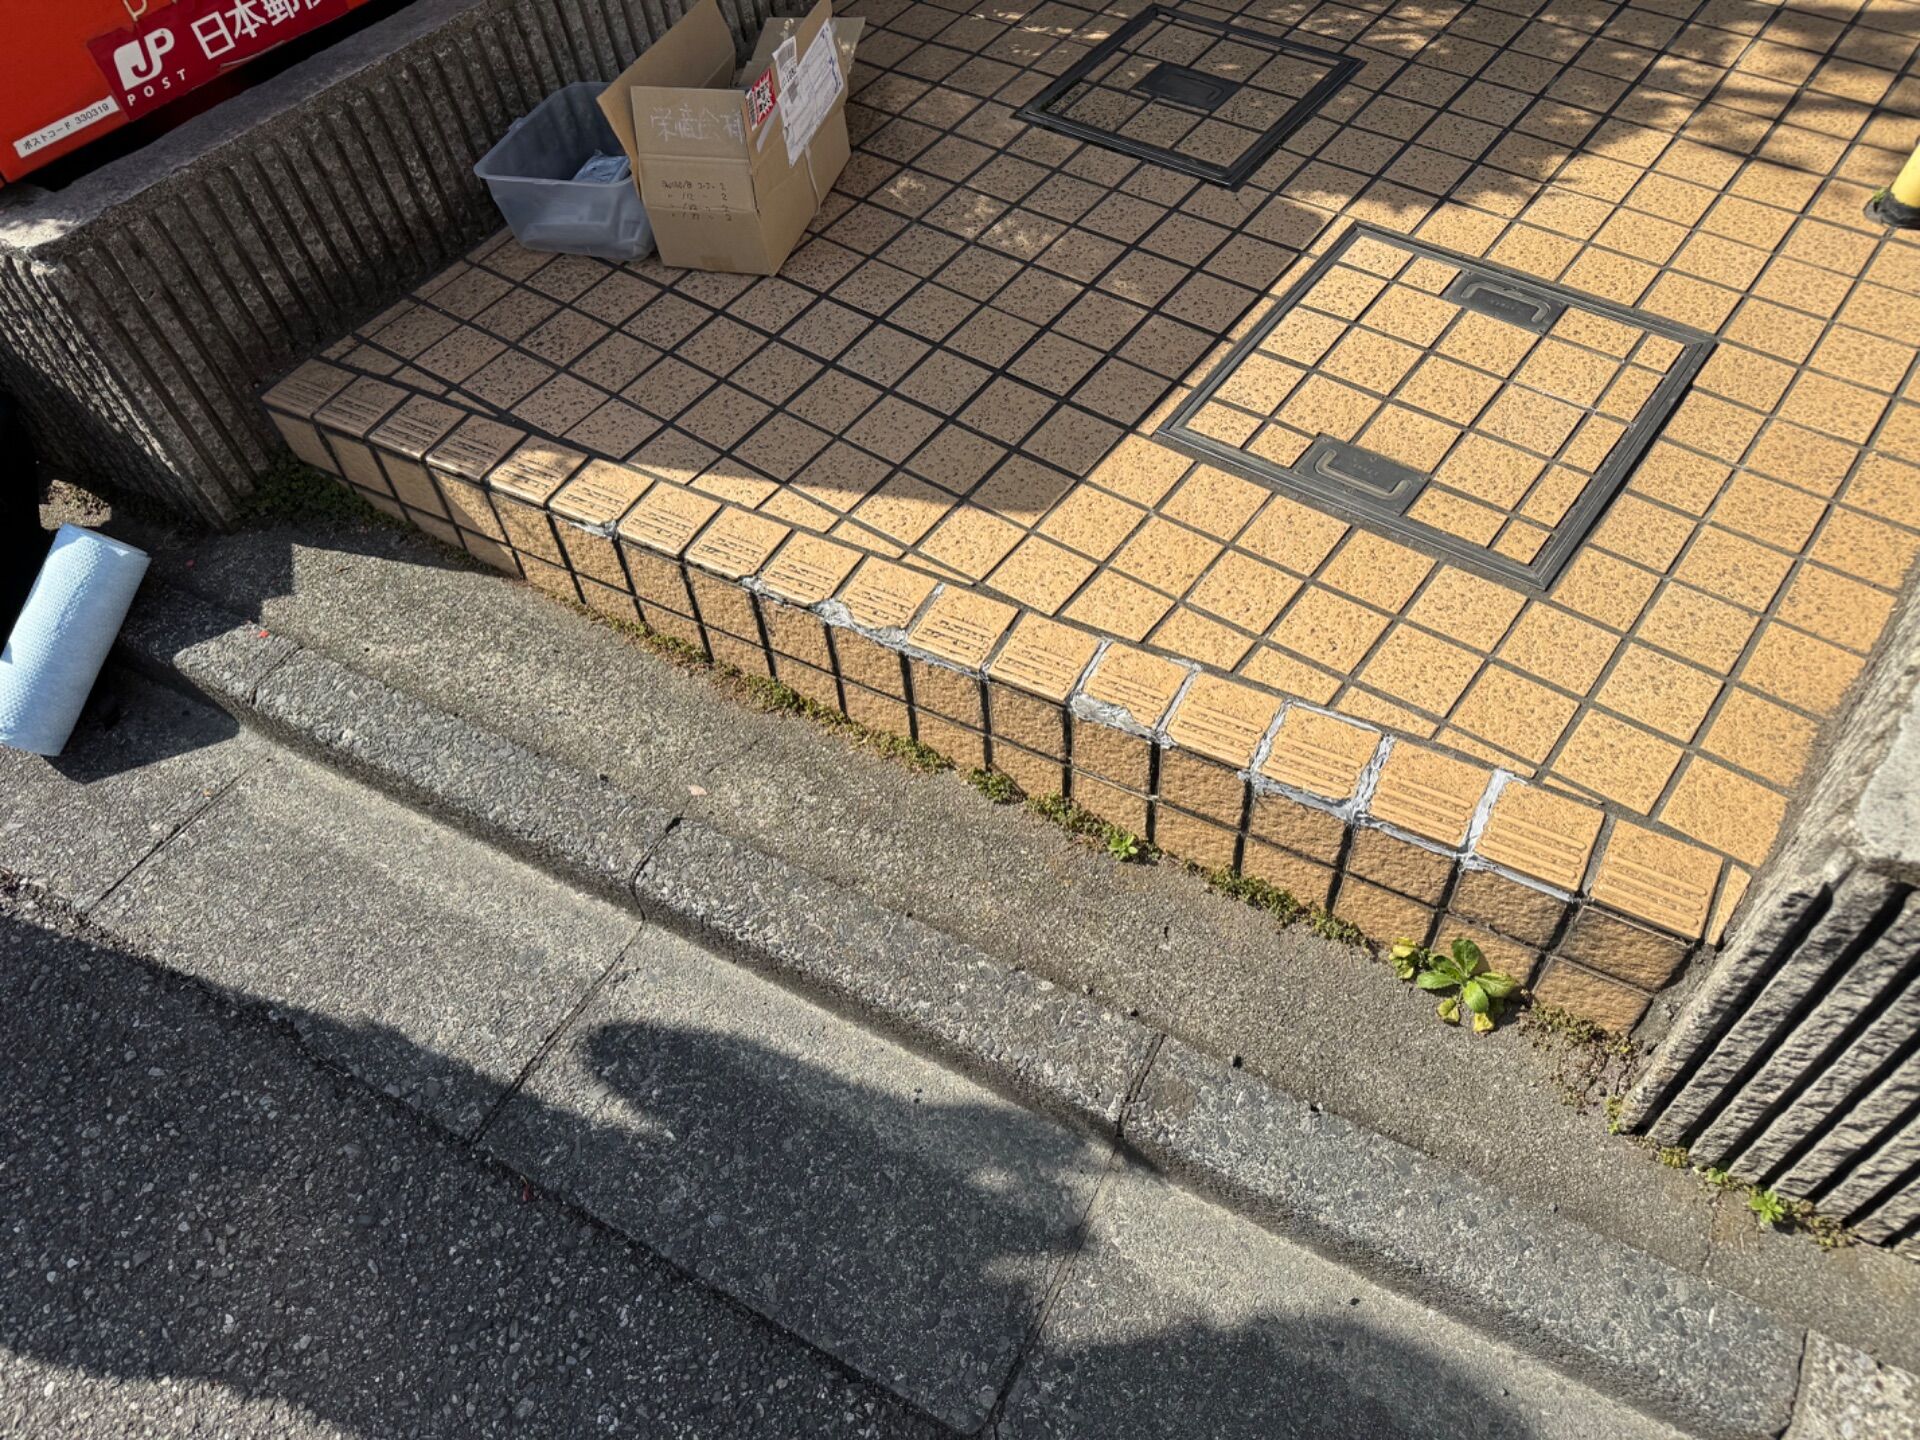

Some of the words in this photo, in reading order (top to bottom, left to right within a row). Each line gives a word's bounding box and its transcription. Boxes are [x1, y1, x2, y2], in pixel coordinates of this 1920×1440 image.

[127, 68, 187, 107] POST
[23, 120, 73, 151] ポストコード
[74, 102, 111, 126] 330319
